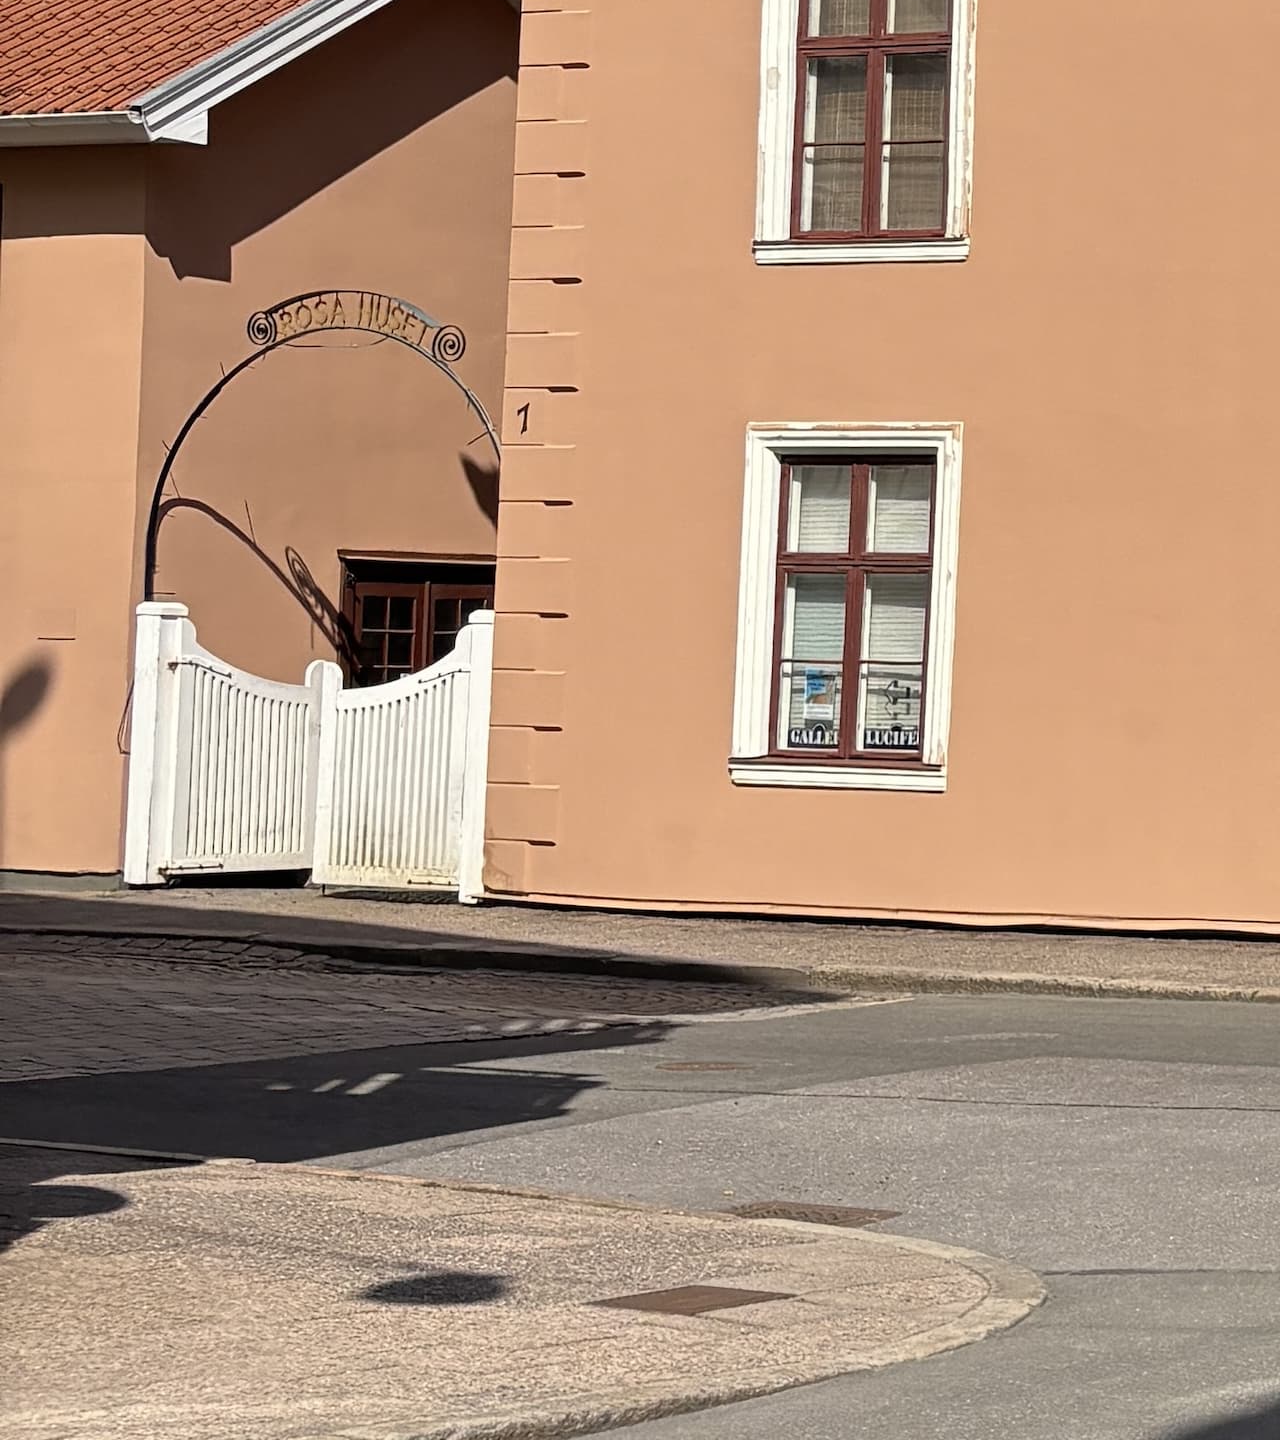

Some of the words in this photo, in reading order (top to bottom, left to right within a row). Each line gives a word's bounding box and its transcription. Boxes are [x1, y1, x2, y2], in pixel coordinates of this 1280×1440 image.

[278, 294, 346, 337] ROSA
[358, 292, 434, 346] HUSET
[866, 730, 919, 745] LUCIFE
